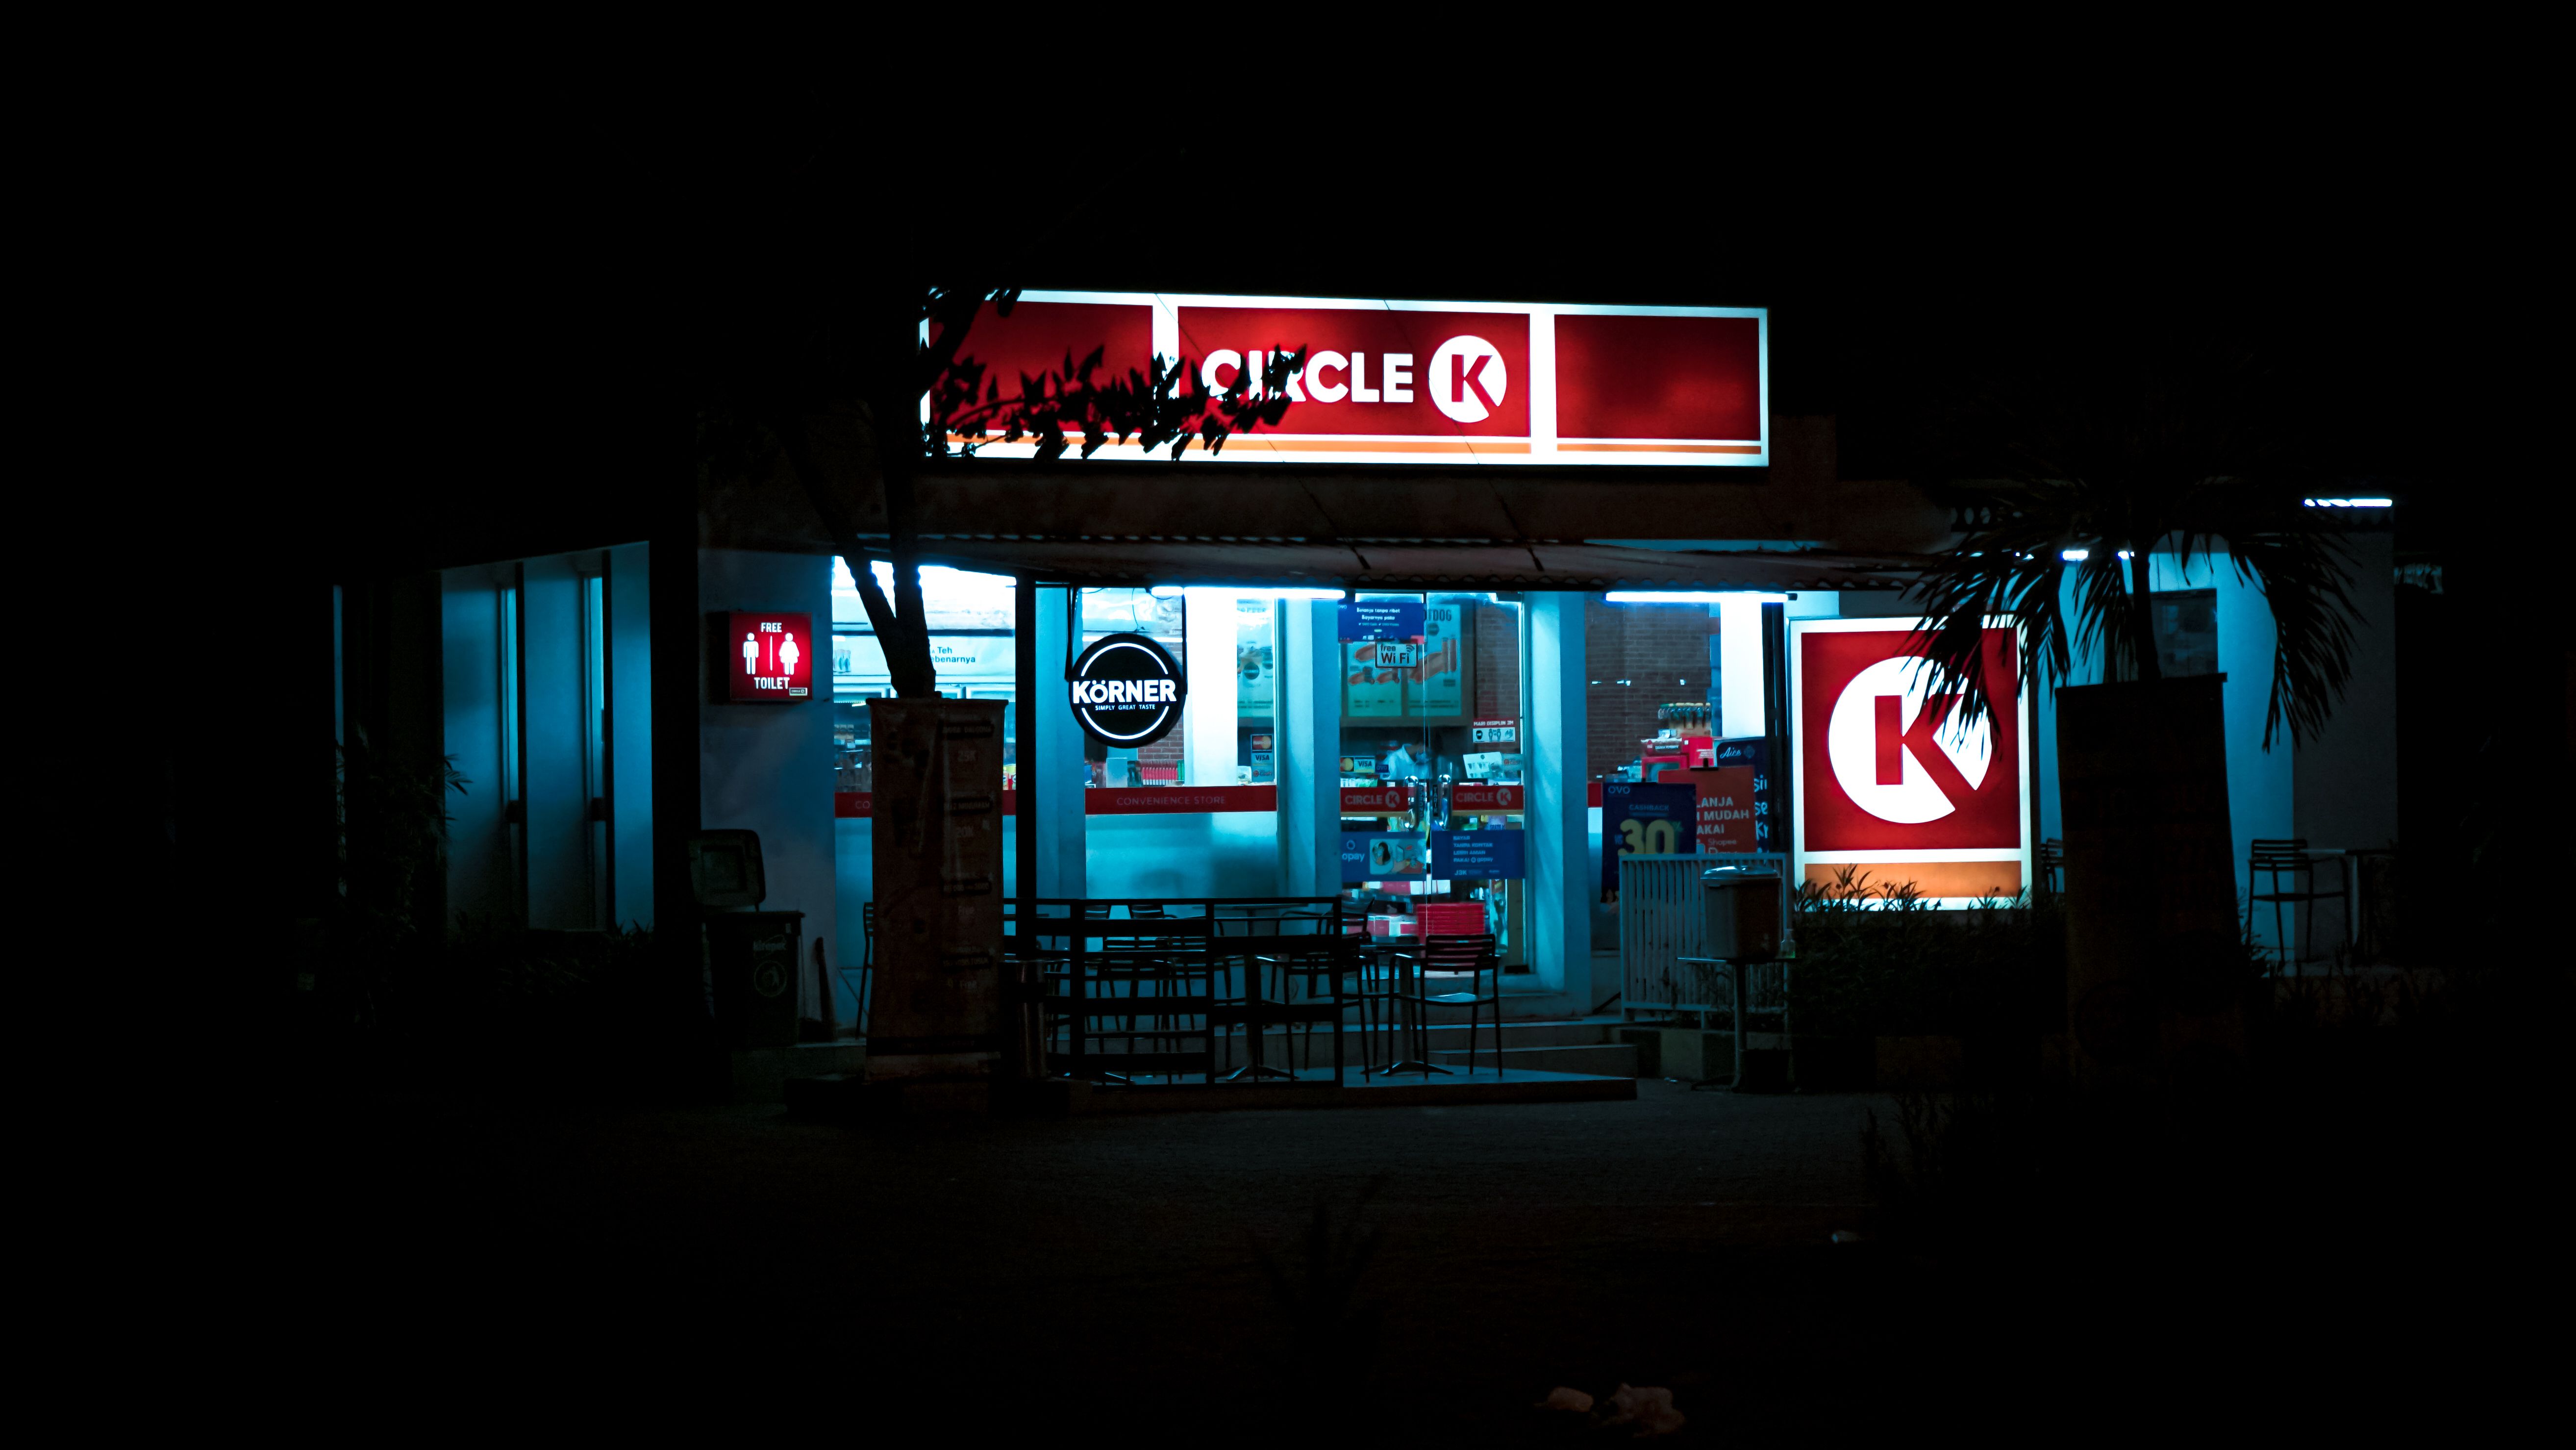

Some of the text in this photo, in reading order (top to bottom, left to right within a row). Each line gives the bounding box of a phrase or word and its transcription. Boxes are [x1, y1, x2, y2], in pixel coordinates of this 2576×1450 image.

[1424, 609, 1452, 622] OTDOG
[761, 622, 782, 633] FREE
[1380, 643, 1396, 652] free
[931, 656, 975, 664] ebenarnya
[754, 677, 790, 689] TOILET
[1720, 747, 1741, 759] Aice
[1608, 786, 1630, 794] OVO
[1117, 796, 1225, 806] CONVENIENCE STORE
[1345, 795, 1382, 805] CIRCLE
[1456, 792, 1494, 802] CIRCLE
[1697, 796, 1733, 808] ANJA
[1704, 810, 1750, 821] MUDAH
[1697, 824, 1725, 835] AKAI
[1708, 838, 1737, 847] Shopee
[1342, 853, 1365, 863] opay
